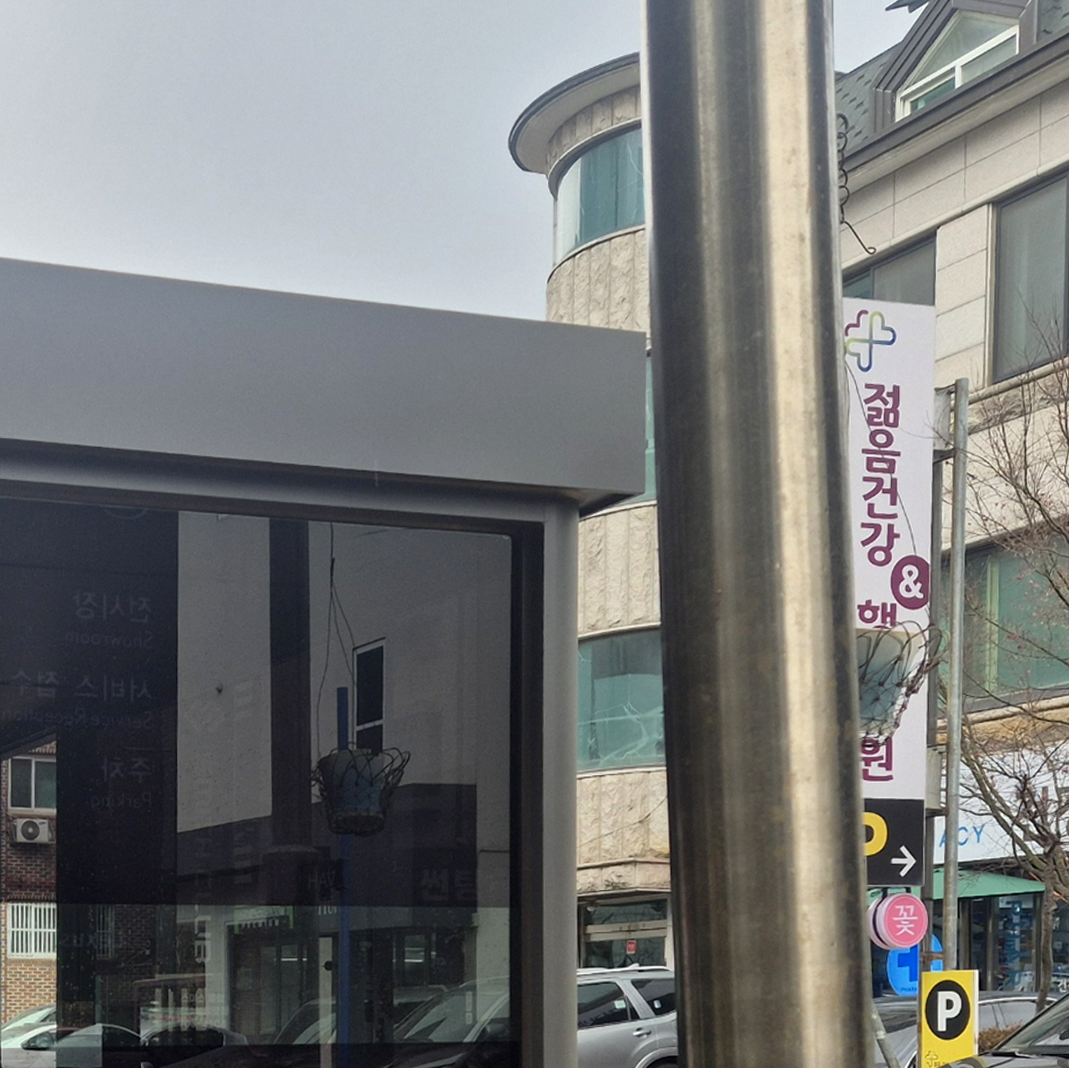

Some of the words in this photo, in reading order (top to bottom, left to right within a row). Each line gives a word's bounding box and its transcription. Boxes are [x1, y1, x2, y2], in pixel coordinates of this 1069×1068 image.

[860, 382, 901, 567] 젊음건강
[898, 565, 924, 600] &
[892, 904, 918, 936] 꽃
[936, 990, 963, 1032] P
